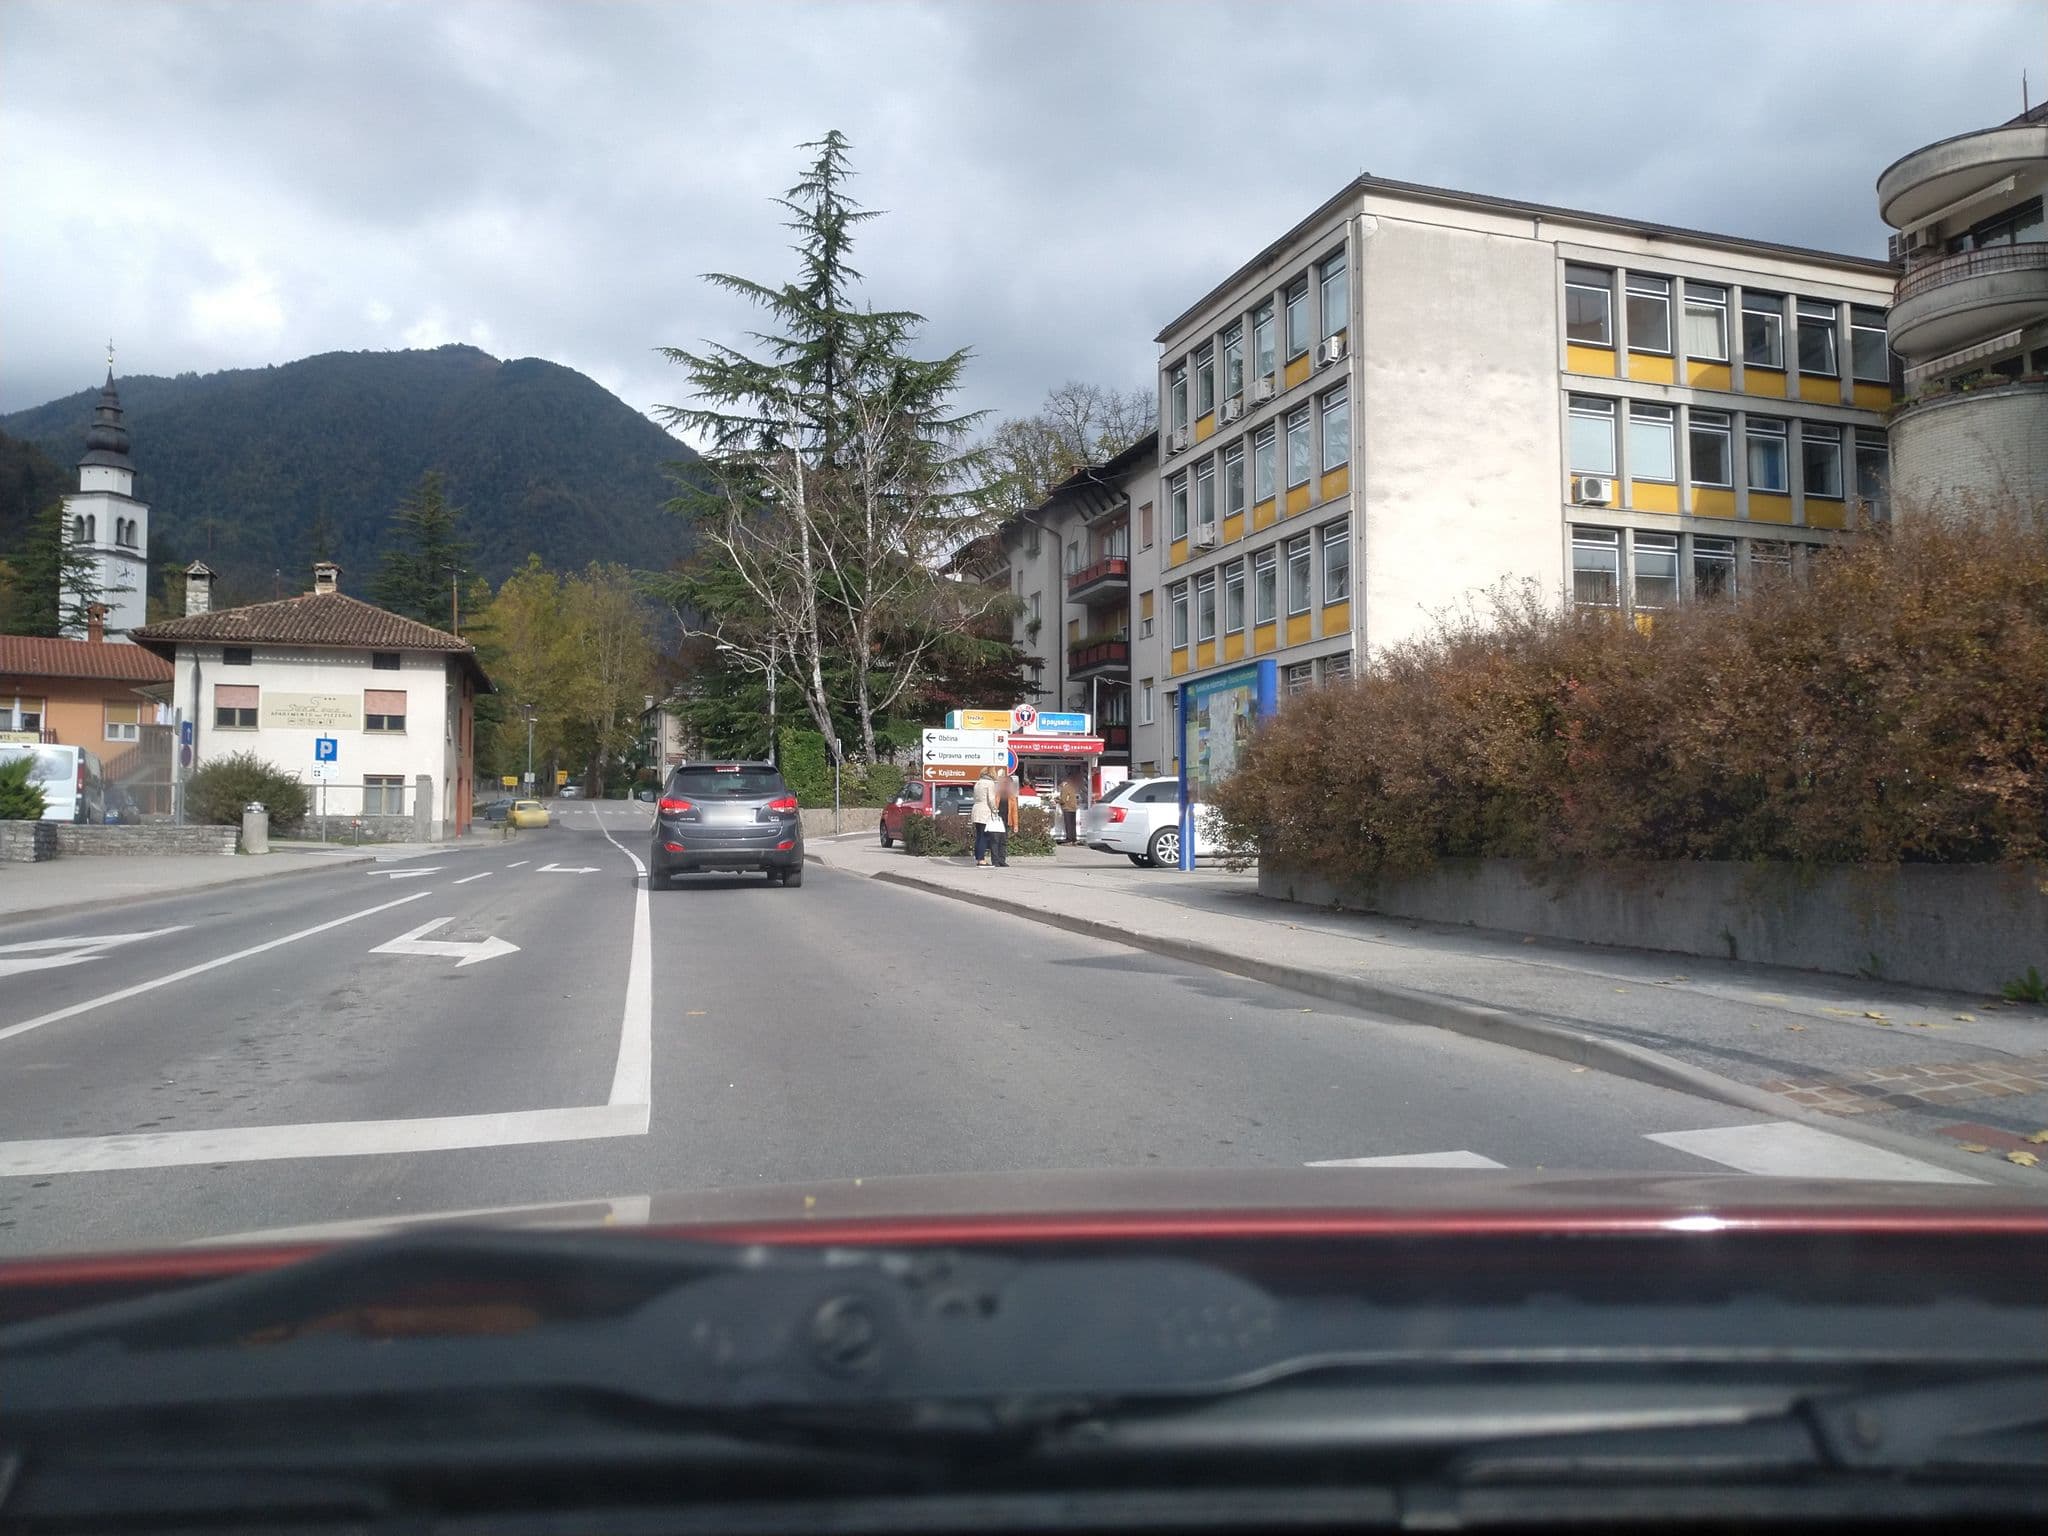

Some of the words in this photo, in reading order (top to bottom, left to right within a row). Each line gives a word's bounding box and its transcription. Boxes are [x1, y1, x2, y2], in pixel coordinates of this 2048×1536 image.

[938, 734, 958, 742] Občina
[320, 740, 333, 759] P
[938, 752, 962, 761] Upravna
[964, 752, 981, 760] enota
[938, 768, 966, 778] Knjižnica
